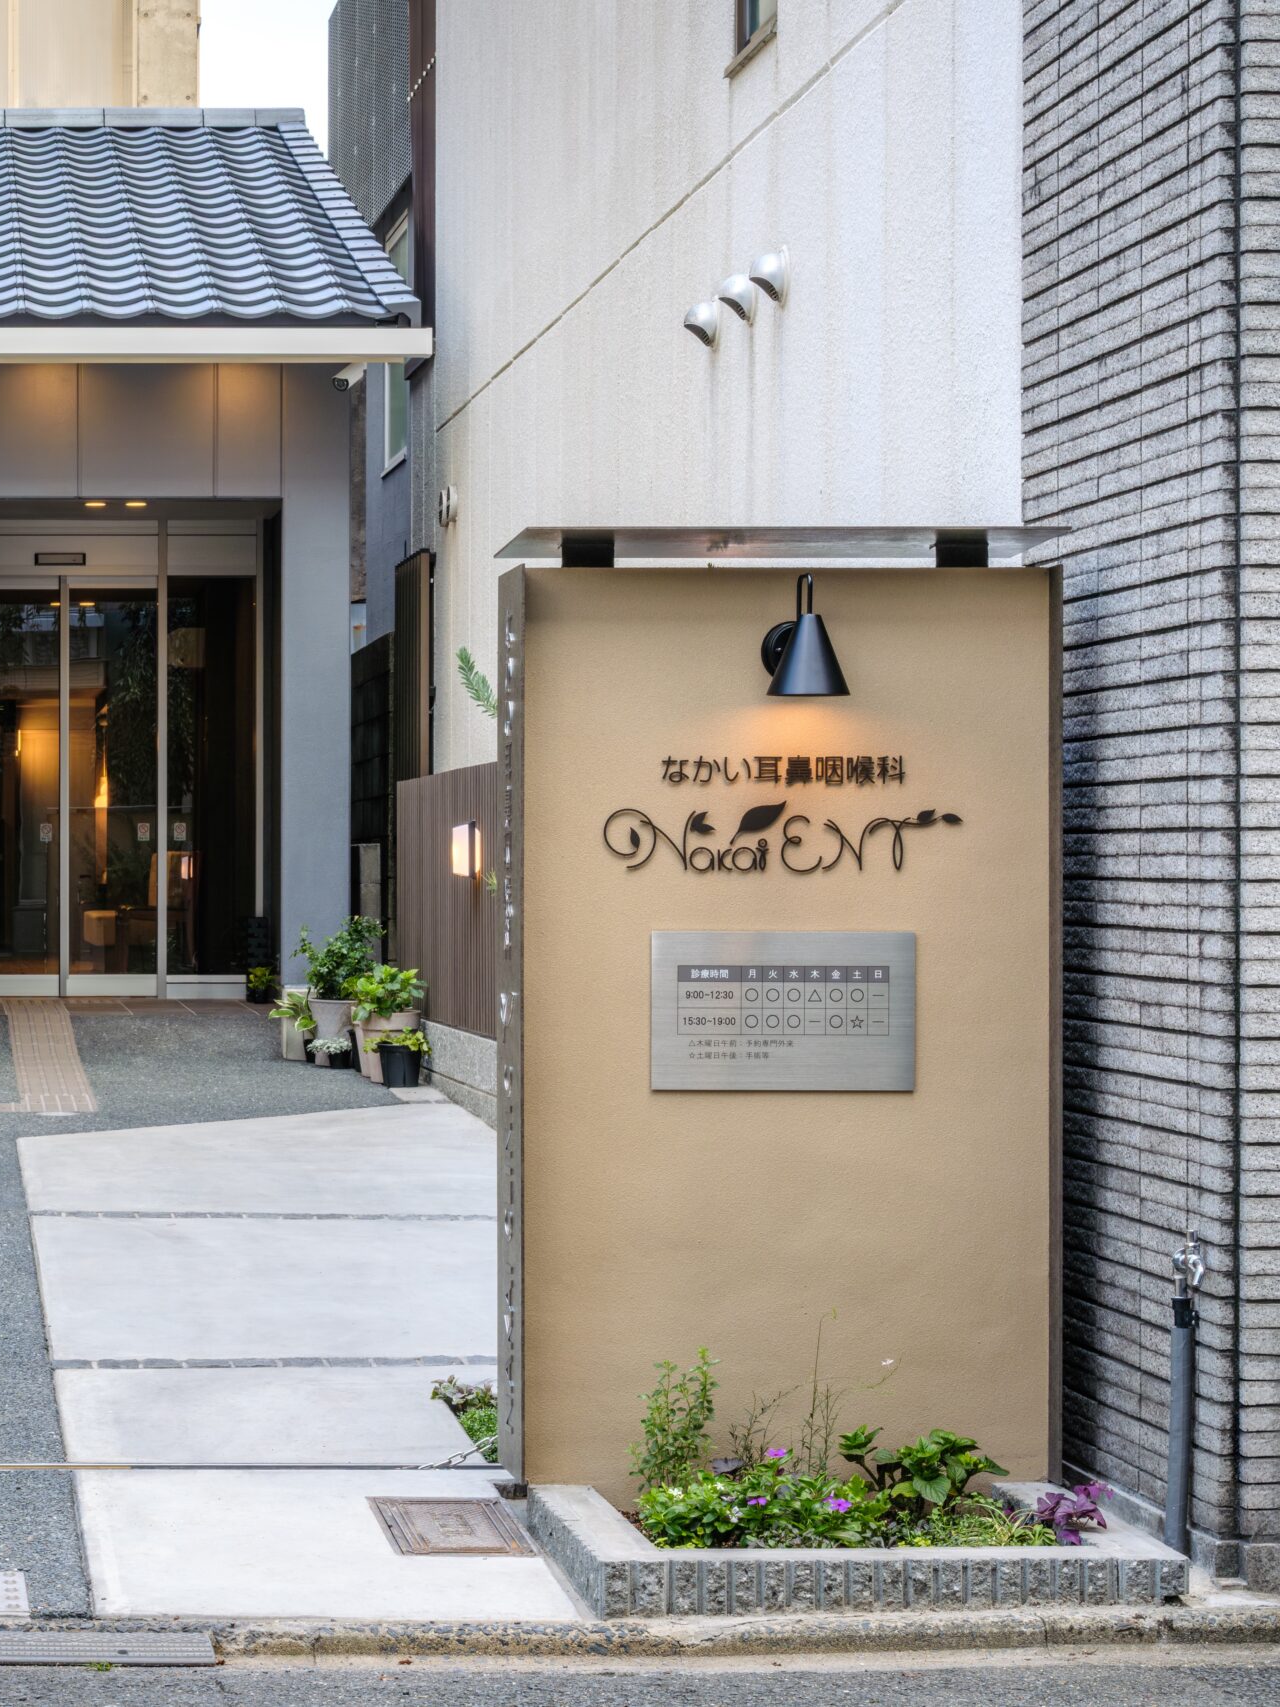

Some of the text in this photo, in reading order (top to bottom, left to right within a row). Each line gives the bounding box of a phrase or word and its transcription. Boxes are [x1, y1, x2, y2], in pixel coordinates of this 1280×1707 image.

[661, 754, 906, 785] なかい耳鼻咽喉科
[604, 808, 936, 873] Nakai ENT
[690, 969, 883, 980] 診療時間 月 火 水 木 金 土 日
